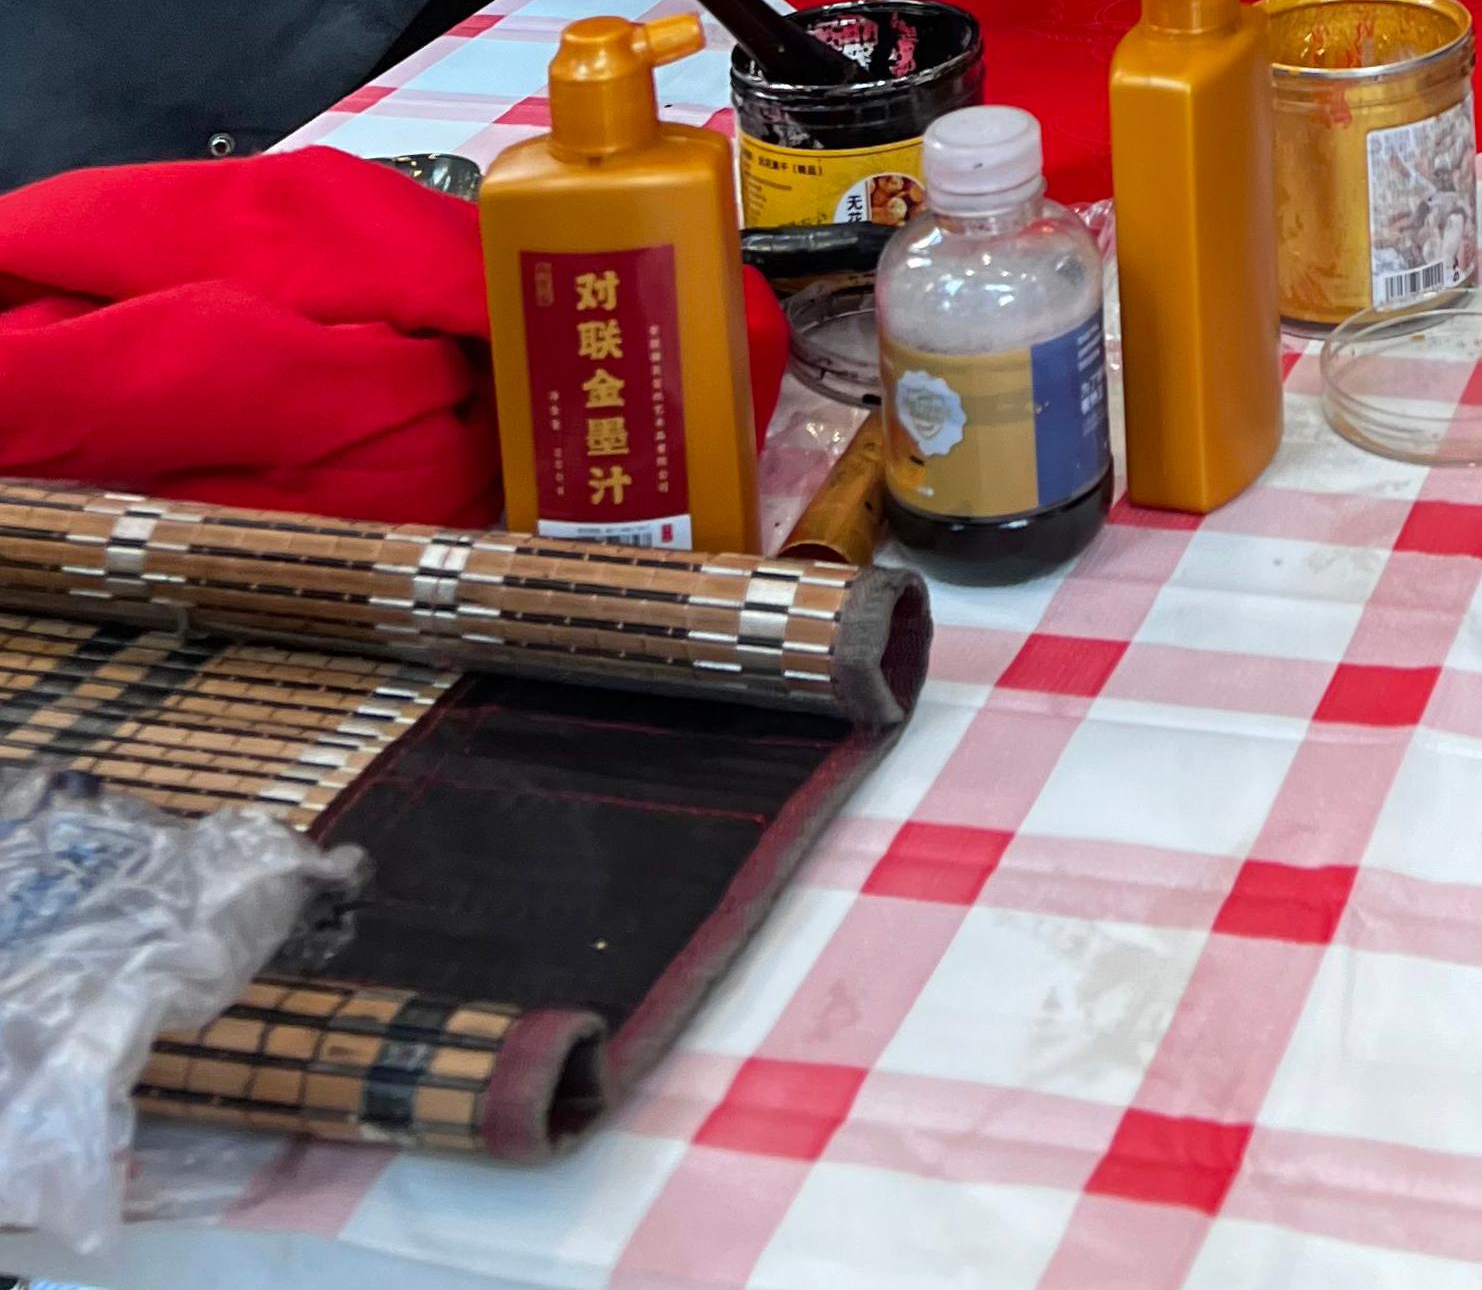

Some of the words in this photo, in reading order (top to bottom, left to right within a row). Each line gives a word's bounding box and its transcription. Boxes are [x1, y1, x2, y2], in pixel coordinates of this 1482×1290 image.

[574, 271, 631, 505] 对联金墨汁
